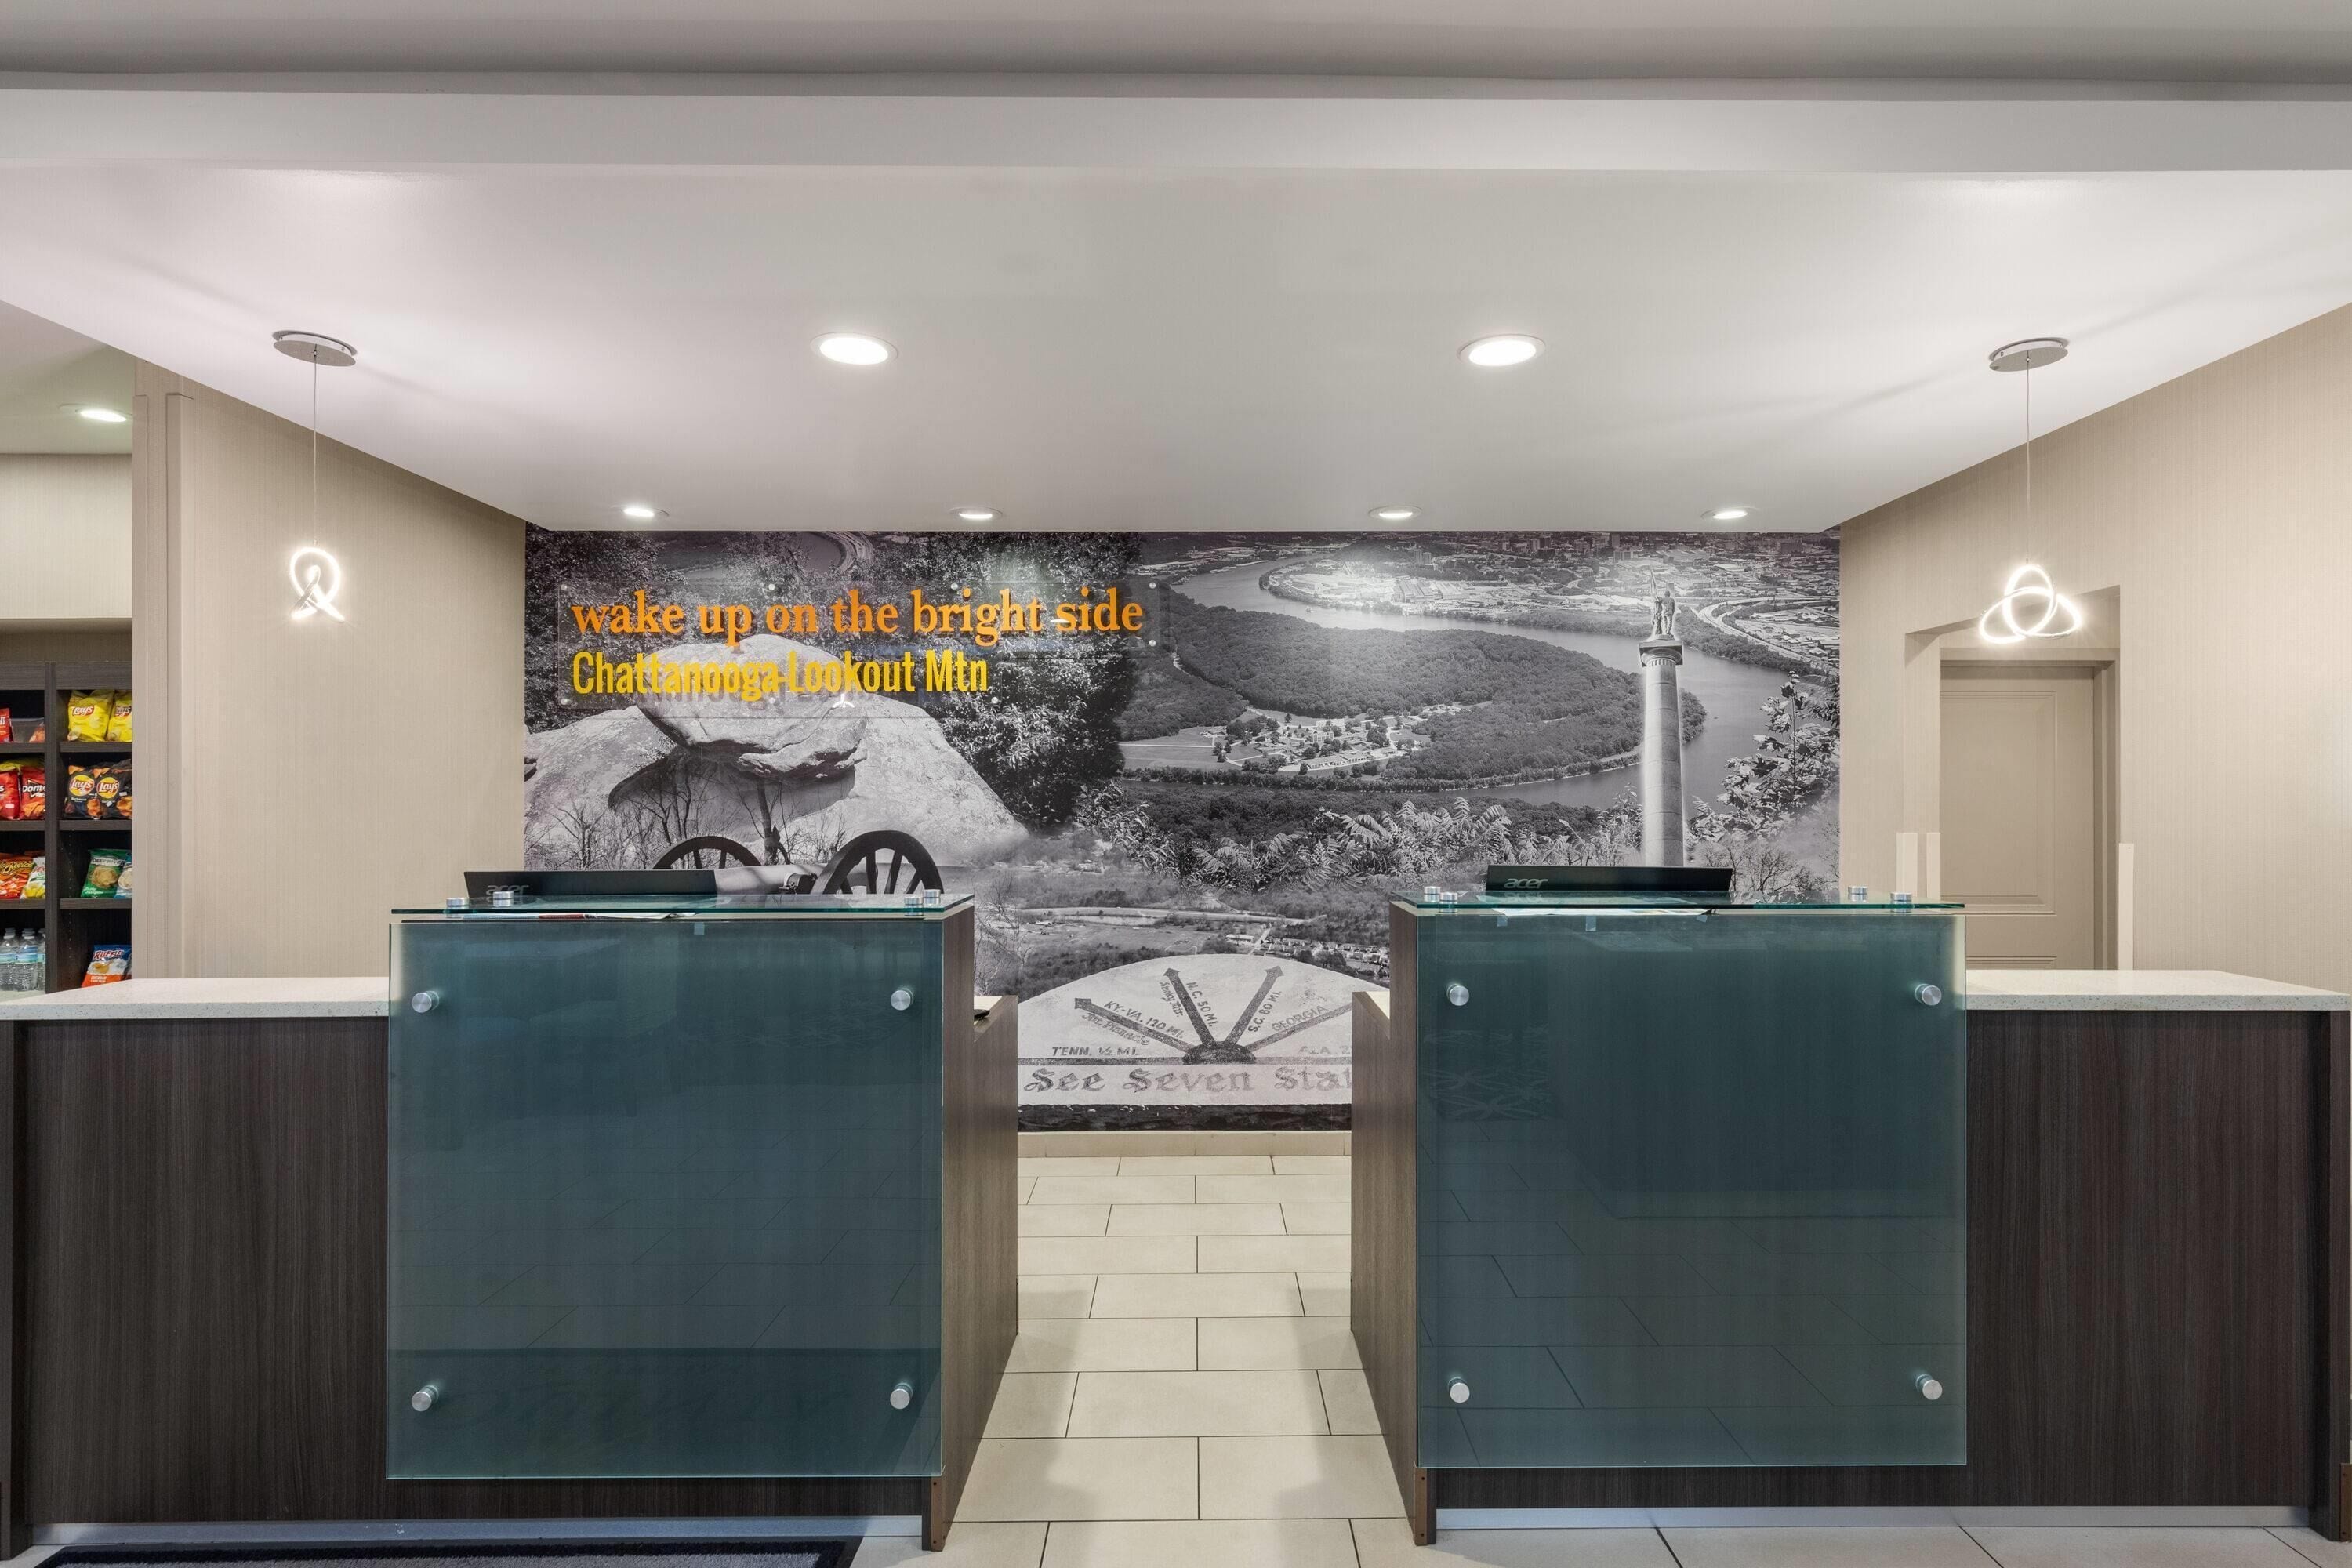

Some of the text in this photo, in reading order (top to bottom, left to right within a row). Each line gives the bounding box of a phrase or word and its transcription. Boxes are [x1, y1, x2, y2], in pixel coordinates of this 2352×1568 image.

[572, 586, 1144, 647] wake up on the bright side
[572, 649, 989, 702] Chattanooga-Lookout Mtn
[99, 780, 119, 793] Lay's
[486, 884, 529, 896] acer
[1504, 878, 1548, 889] acer
[1197, 1000, 1212, 1012] 50
[1258, 1004, 1274, 1015] 80
[1145, 1017, 1167, 1030] 120
[1271, 1004, 1330, 1032] GEORGIA
[1023, 1067, 1105, 1093] See
[1122, 1067, 1255, 1093] Seven
